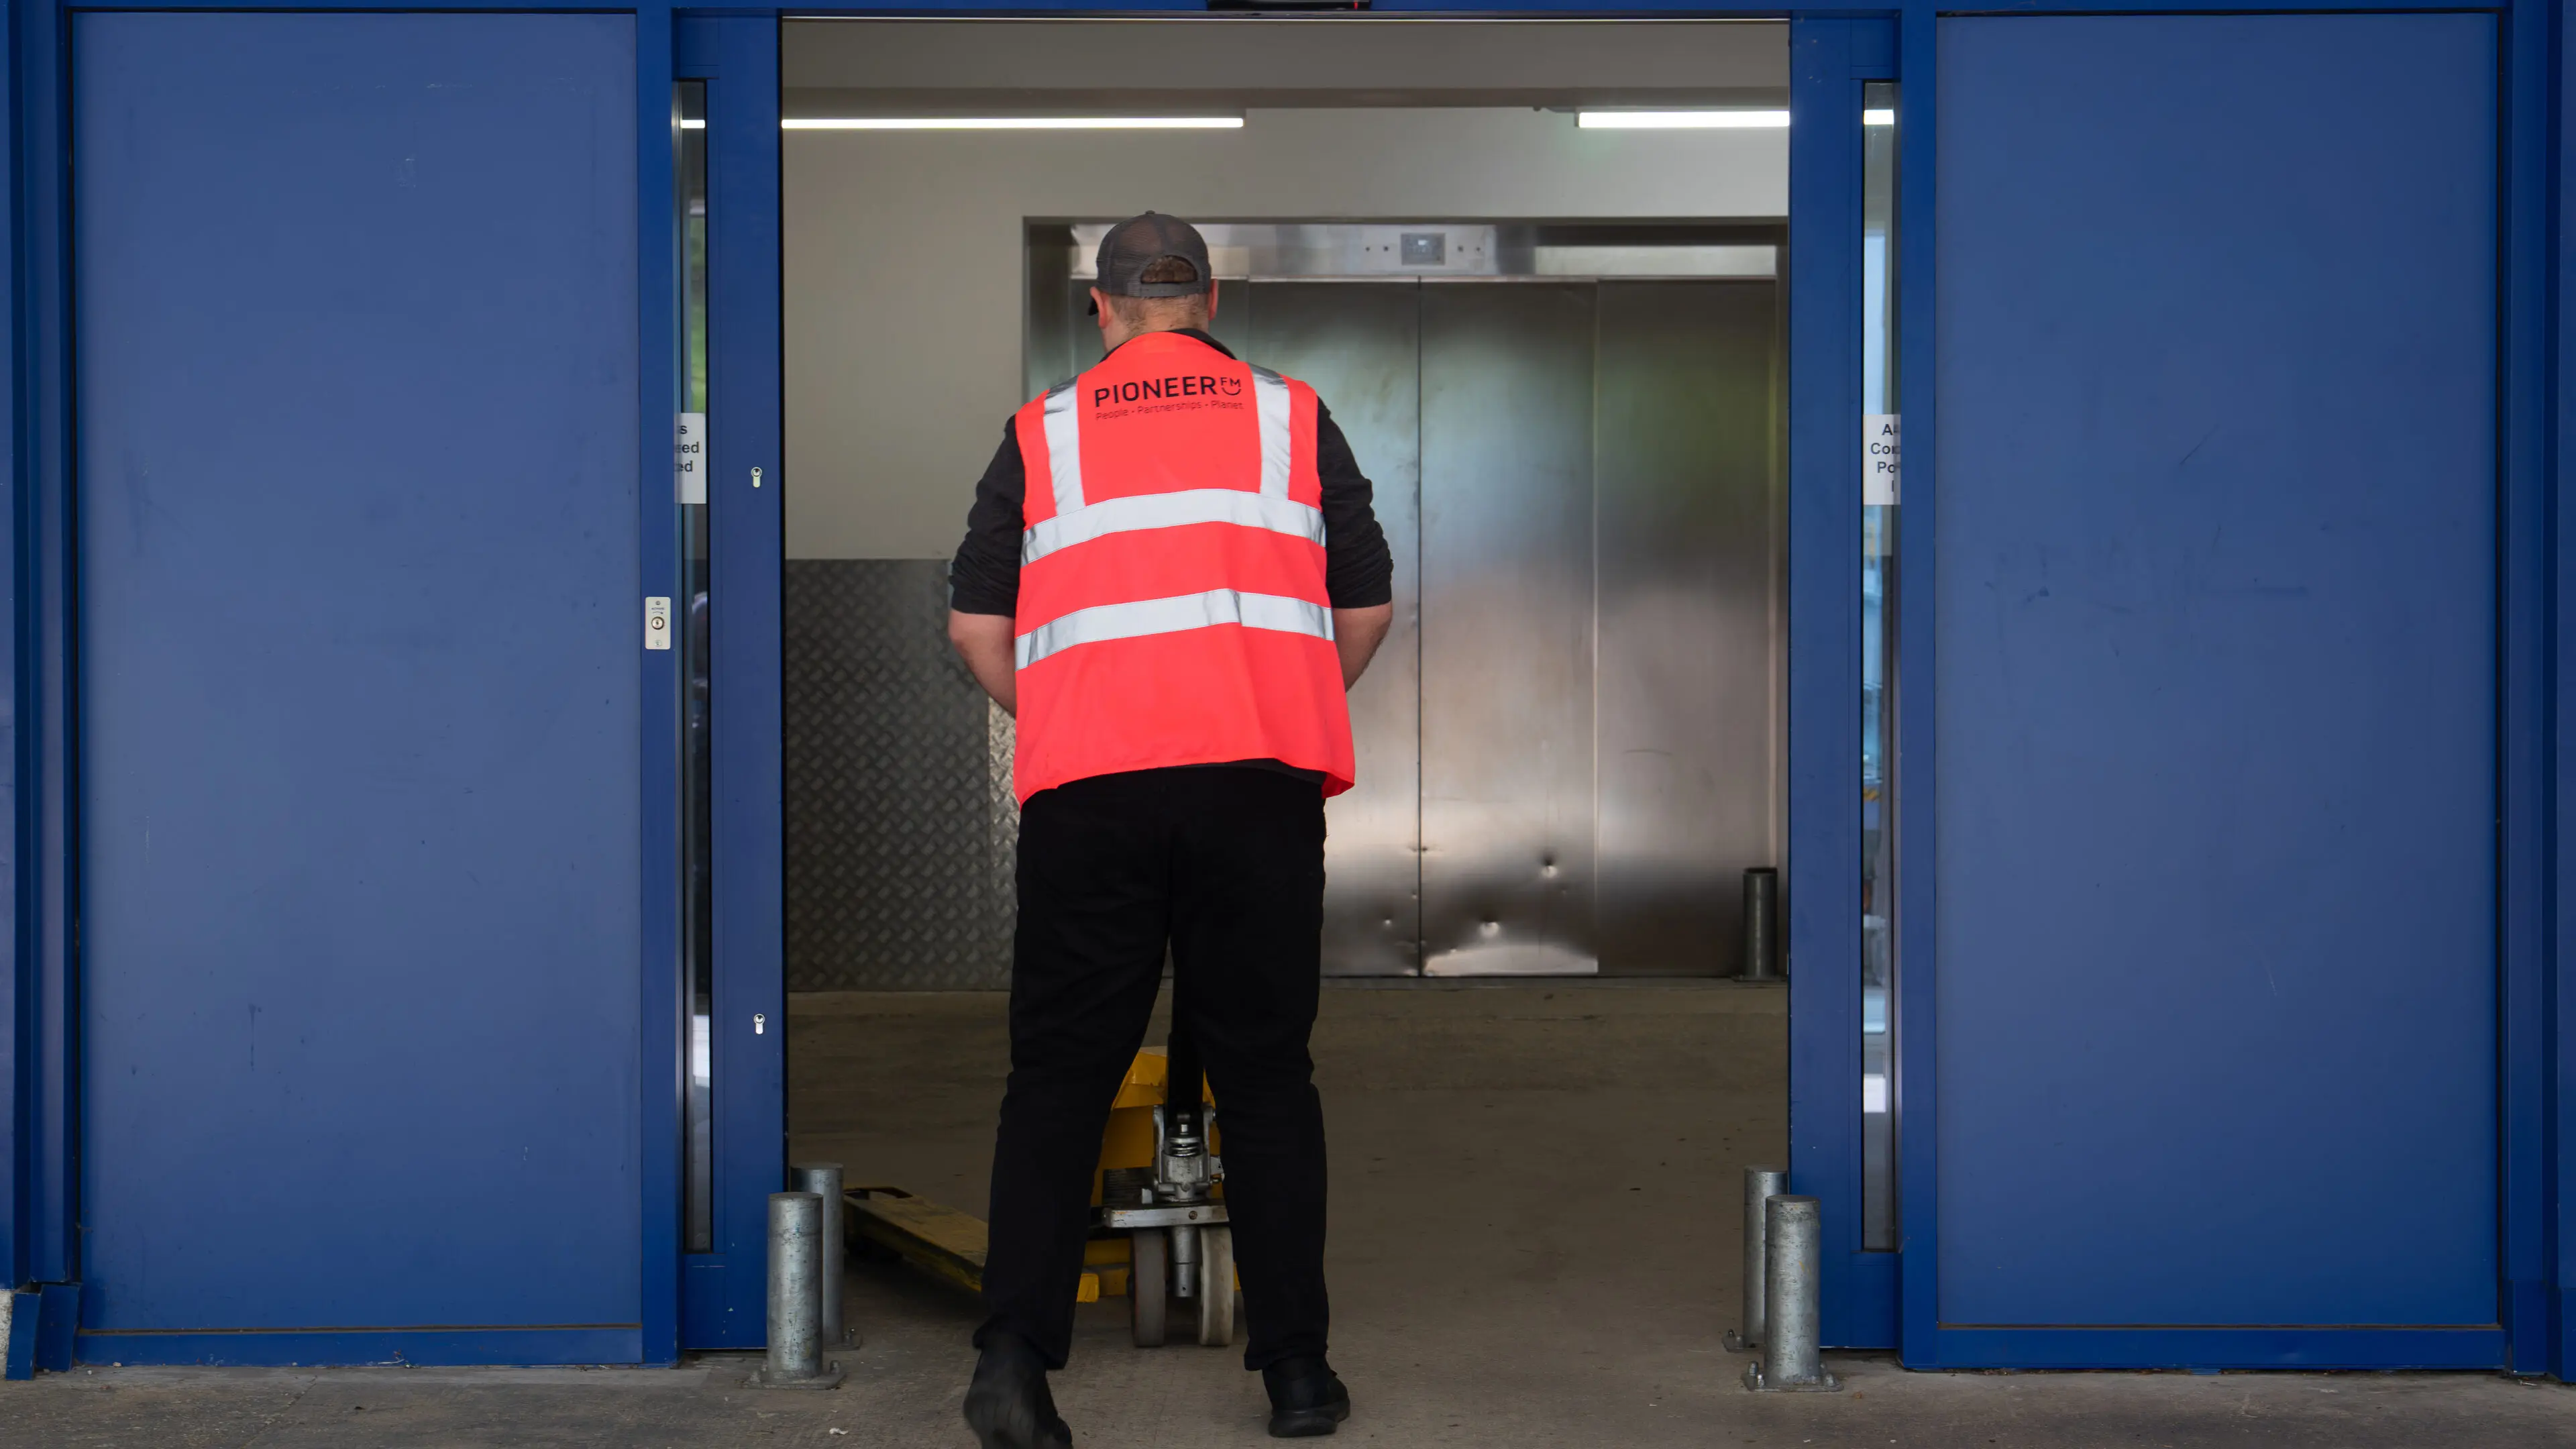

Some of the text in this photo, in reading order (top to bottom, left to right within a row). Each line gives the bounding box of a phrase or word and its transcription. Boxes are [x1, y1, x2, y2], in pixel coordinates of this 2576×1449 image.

[1095, 376, 1241, 407] PIONEER FM
[1096, 400, 1244, 421] People Partnerships Planet
